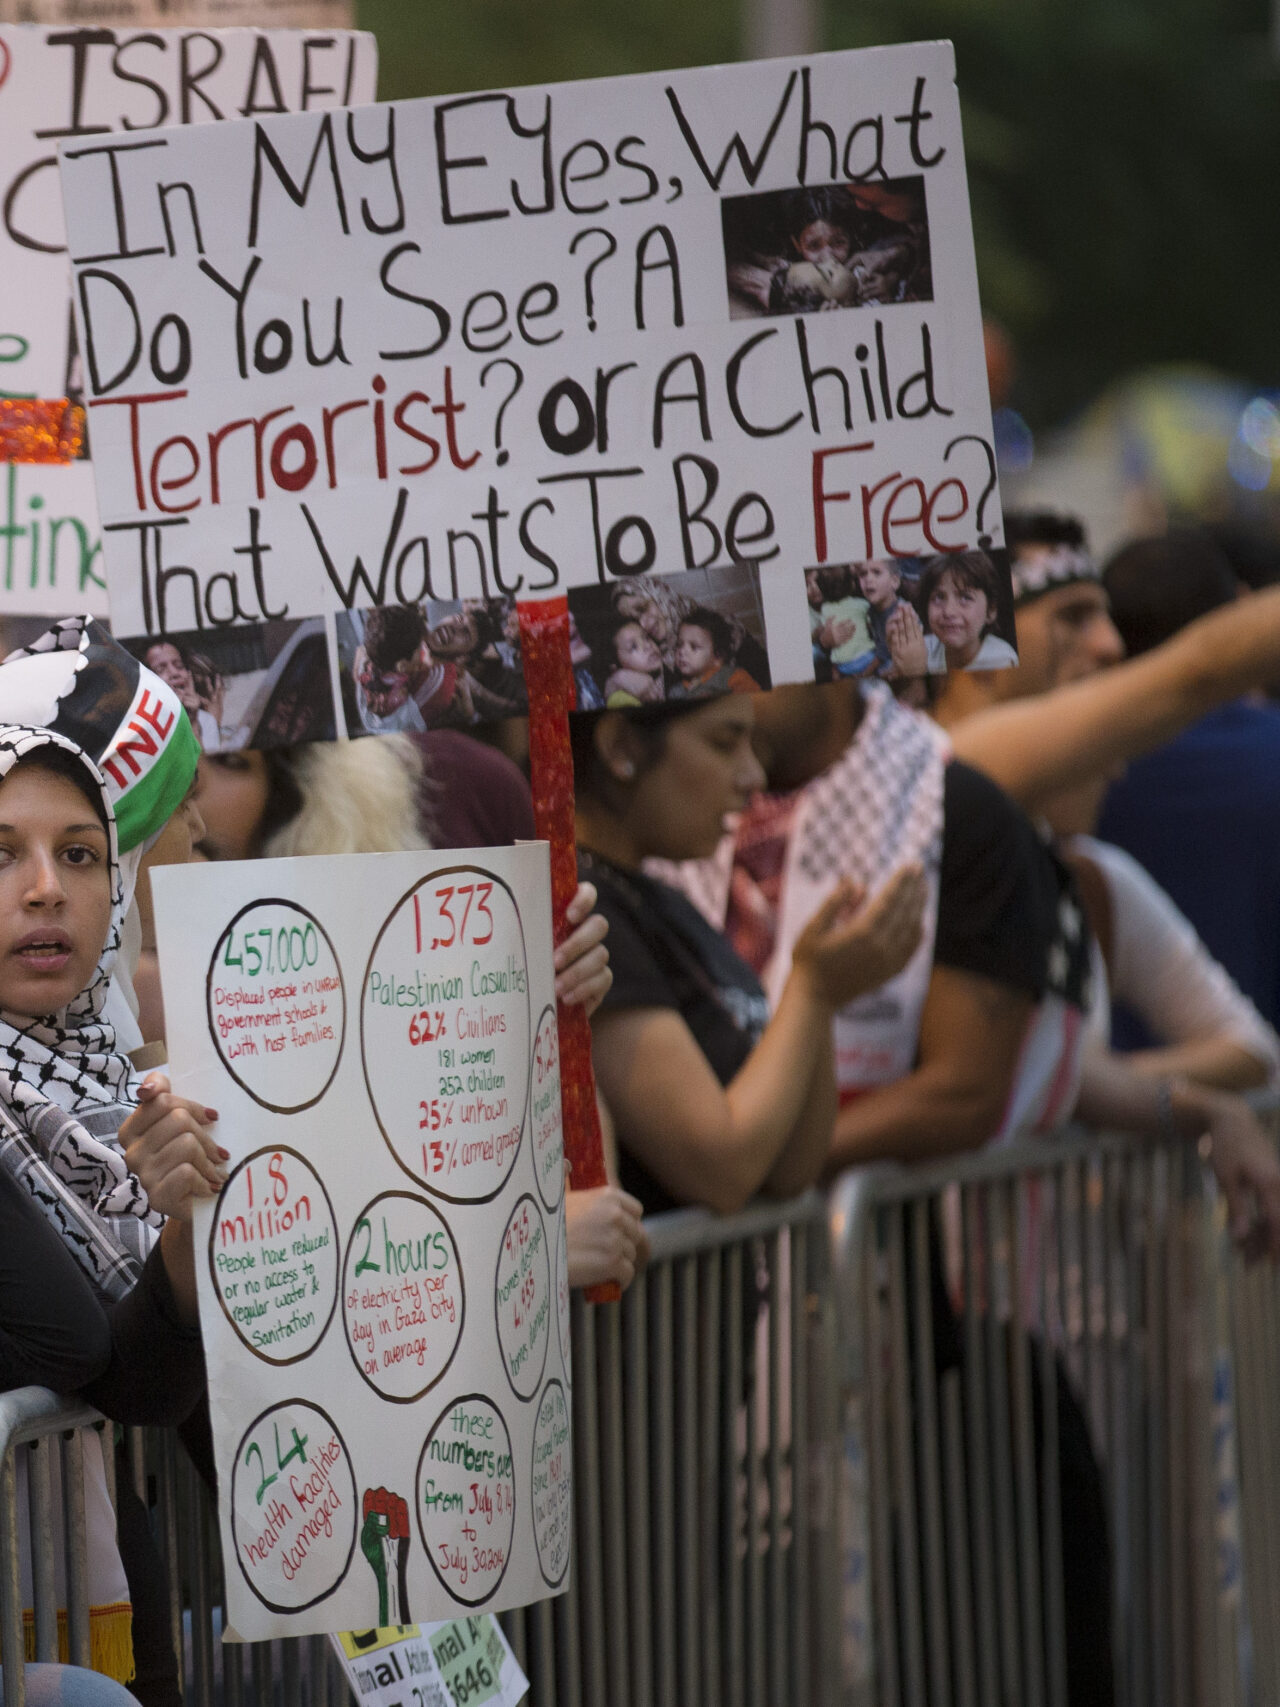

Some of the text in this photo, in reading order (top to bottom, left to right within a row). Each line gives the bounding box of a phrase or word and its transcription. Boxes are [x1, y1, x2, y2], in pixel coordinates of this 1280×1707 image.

[64, 139, 206, 265] In
[664, 66, 947, 192] What
[78, 225, 685, 396] Do You See? A
[88, 358, 524, 514] Terrorist?
[652, 352, 713, 449] A
[725, 317, 954, 438] Child
[103, 435, 998, 636] That Wants To Be Free?
[102, 688, 176, 790] INE
[412, 882, 495, 954] 1,373
[224, 922, 319, 977] 457,000
[214, 986, 266, 1011] Displaced
[268, 983, 298, 1005] people
[302, 981, 314, 996] in
[369, 968, 464, 1008] Palestinian
[408, 1004, 508, 1047] 62% Civilians
[227, 1037, 259, 1060] with
[438, 1047, 496, 1068] 181 women
[439, 1068, 506, 1096] 252 children
[418, 1099, 455, 1131] 25%
[422, 1138, 458, 1177] 13%
[461, 1133, 495, 1167] armed
[261, 1246, 289, 1266] have
[291, 1227, 330, 1256] reduced
[354, 1216, 450, 1278] 2 hours
[224, 1261, 316, 1300] or no access to
[347, 1273, 449, 1311] of electricity per
[353, 1319, 375, 1353] day
[376, 1313, 392, 1336] in
[394, 1305, 428, 1333] Gaza
[363, 1336, 428, 1376] on average
[449, 1406, 495, 1440] these
[245, 1421, 309, 1507] 24
[429, 1438, 495, 1479] numbers
[424, 1478, 464, 1515] from
[468, 1482, 494, 1526] July
[243, 1498, 293, 1567] health
[281, 1480, 343, 1581] damaged
[461, 1520, 478, 1543] to
[438, 1543, 469, 1585] July
